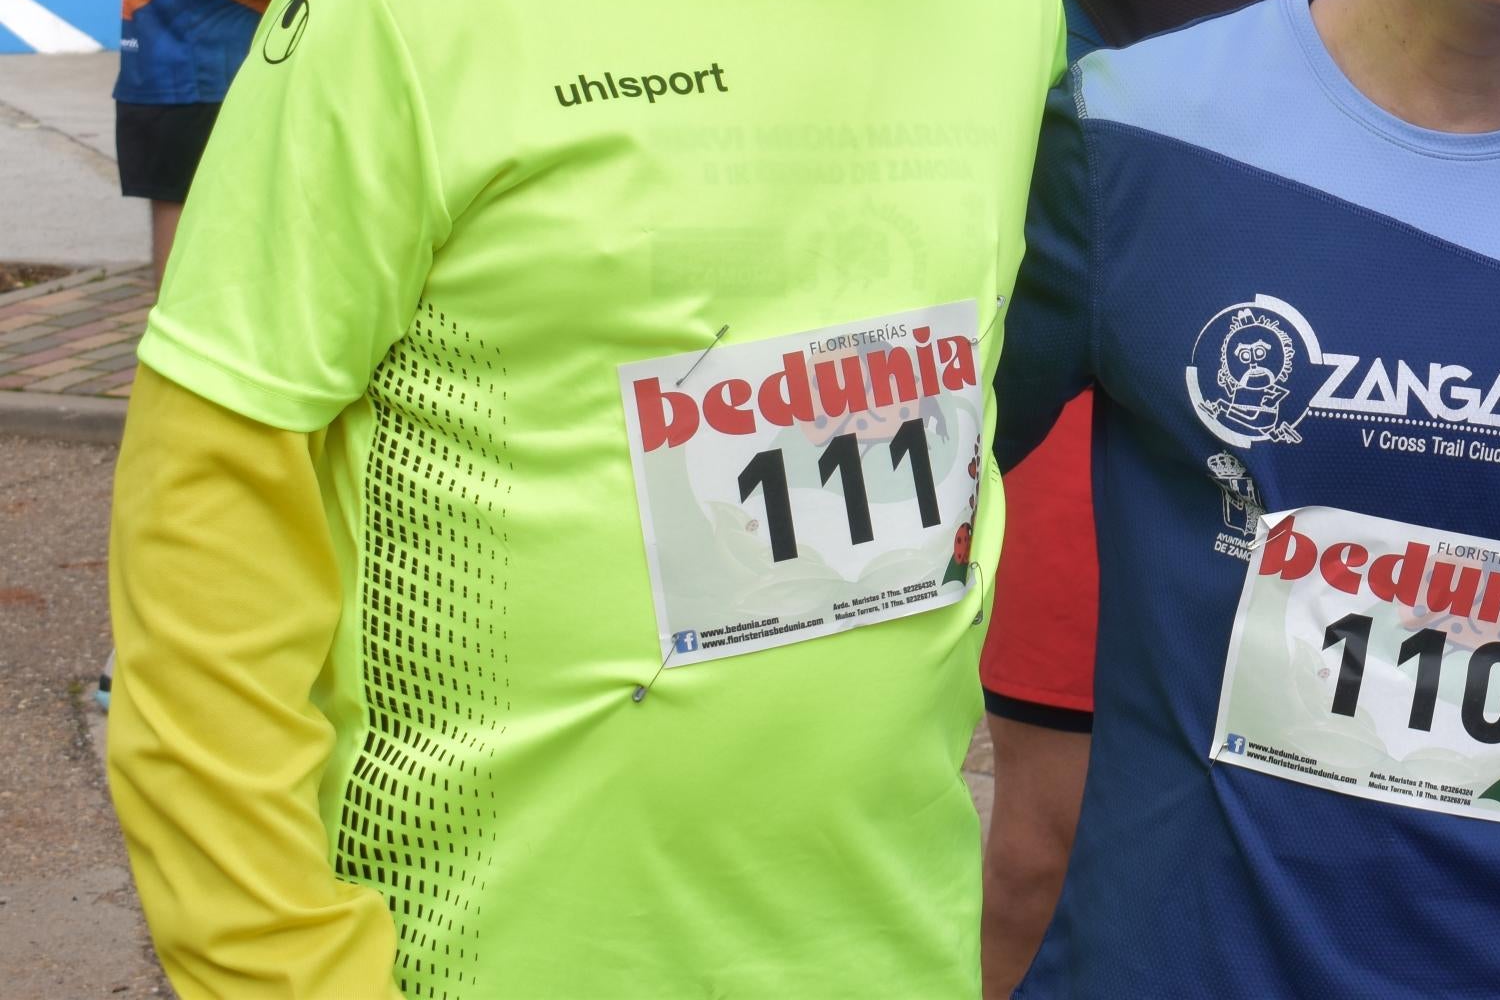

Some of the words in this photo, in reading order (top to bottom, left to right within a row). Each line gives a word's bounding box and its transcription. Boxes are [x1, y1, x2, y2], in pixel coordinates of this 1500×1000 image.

[555, 63, 728, 108] uhlsport
[808, 323, 908, 355] FLORISTERÍAS
[633, 326, 977, 453] bedunia
[1361, 428, 1374, 448] V
[1379, 430, 1426, 453] Cross
[1432, 436, 1464, 458] Trail
[738, 417, 941, 563] 111
[1214, 540, 1228, 553] DE
[1216, 532, 1248, 549] AYUNTAM
[700, 617, 780, 638] www.bedunia.com
[702, 618, 824, 649] www.floristeriasbedunia.com
[1246, 750, 1358, 784] www.floristeriasbedunia.com
[1248, 742, 1318, 766] www.bedunia.com
